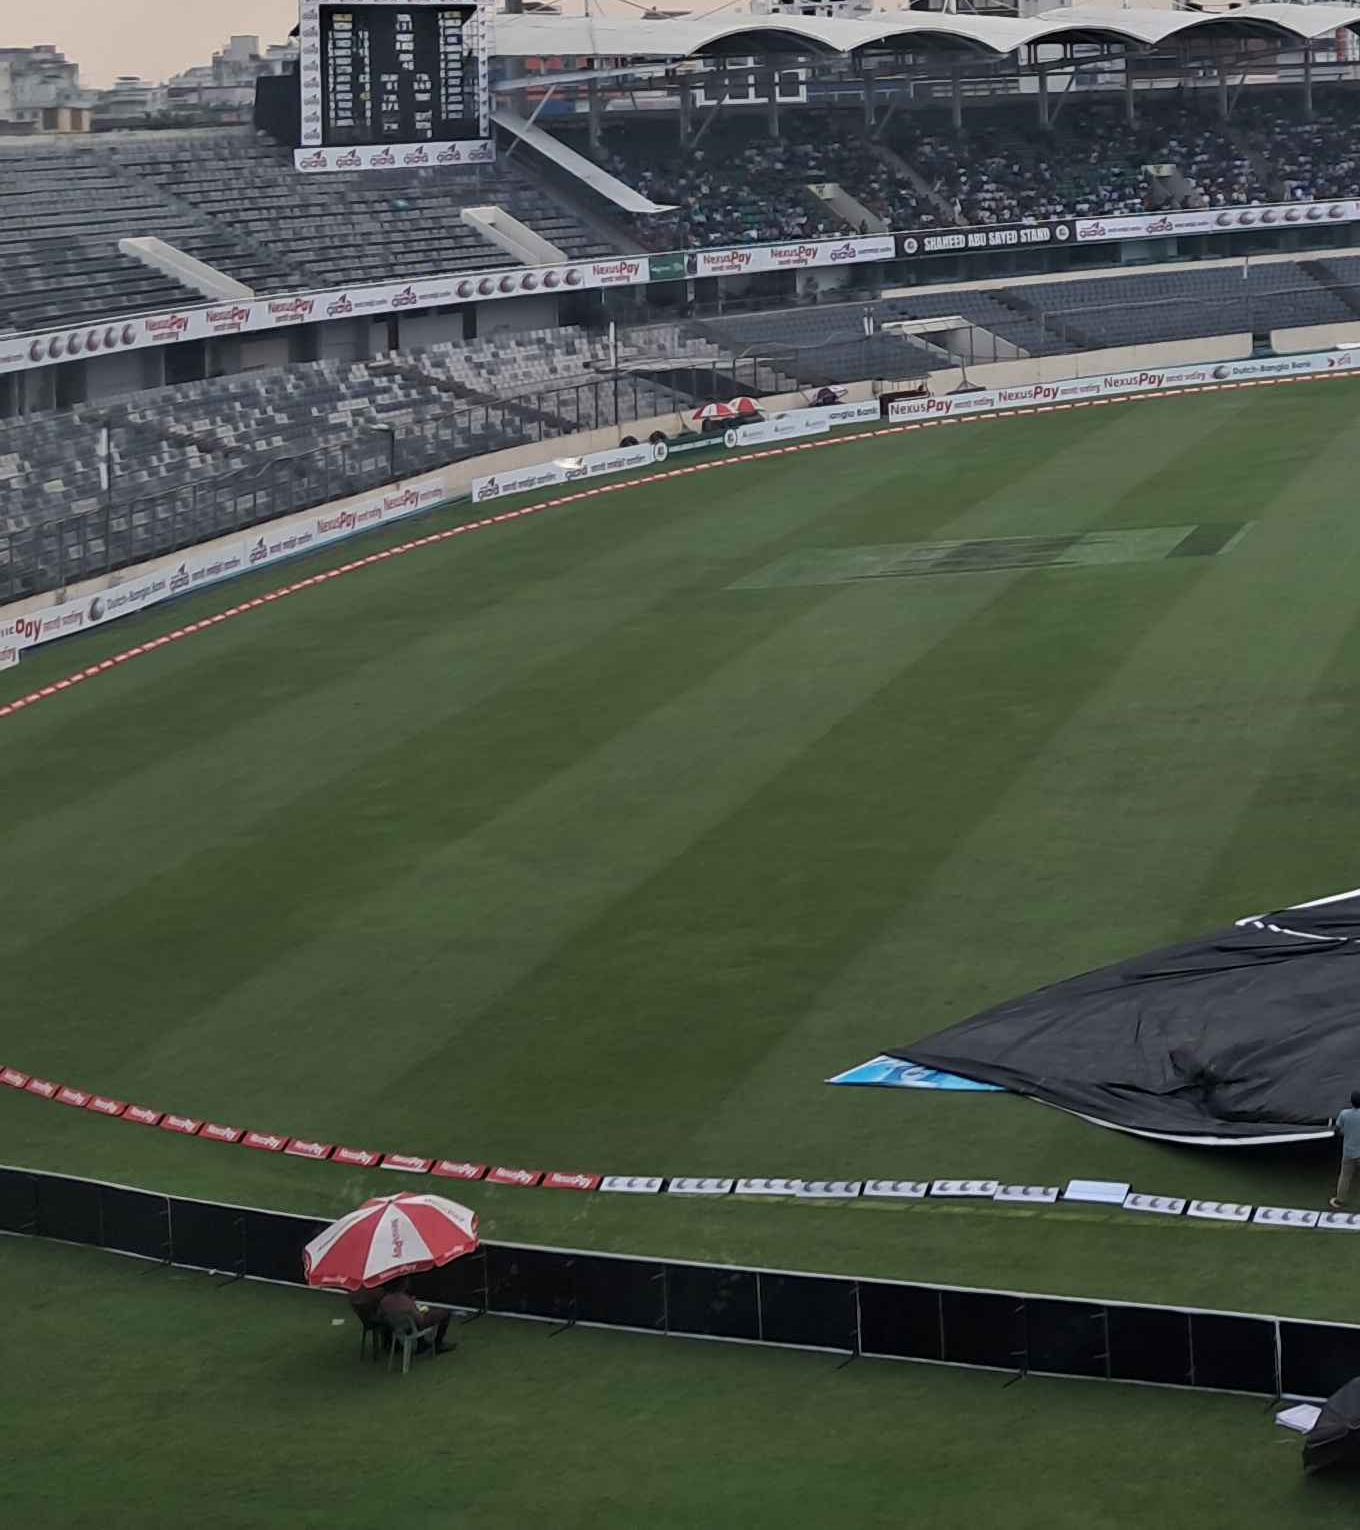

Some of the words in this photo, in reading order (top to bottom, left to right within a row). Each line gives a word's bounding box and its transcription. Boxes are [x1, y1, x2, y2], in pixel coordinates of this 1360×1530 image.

[924, 235, 966, 251] SHAHEED
[968, 233, 987, 247] ABU
[988, 230, 1018, 246] SAYED
[1020, 227, 1050, 243] STAND
[703, 251, 752, 265] NexusPay
[770, 245, 818, 259] NexusPay
[1104, 372, 1166, 389] NexusPay
[998, 385, 1061, 402] NexusPay
[857, 406, 878, 417] Bank
[890, 399, 953, 416] NexusPay
